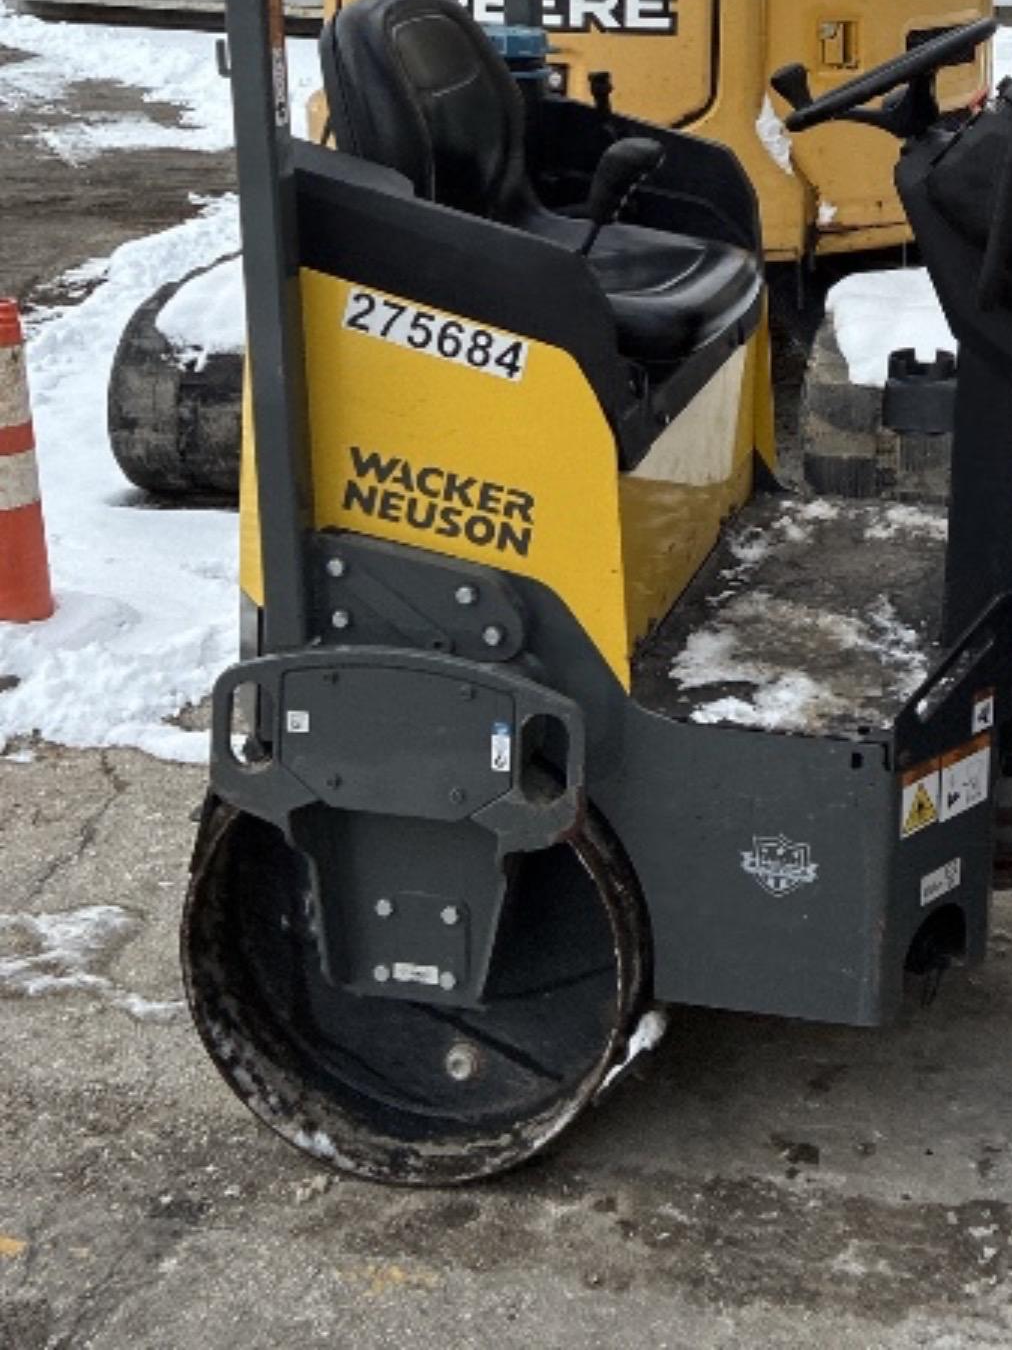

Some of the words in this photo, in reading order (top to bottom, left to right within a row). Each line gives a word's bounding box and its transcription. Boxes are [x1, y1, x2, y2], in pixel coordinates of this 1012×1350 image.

[346, 292, 524, 380] 275684
[341, 479, 532, 557] NEUSON
[350, 446, 535, 525] WACKER
